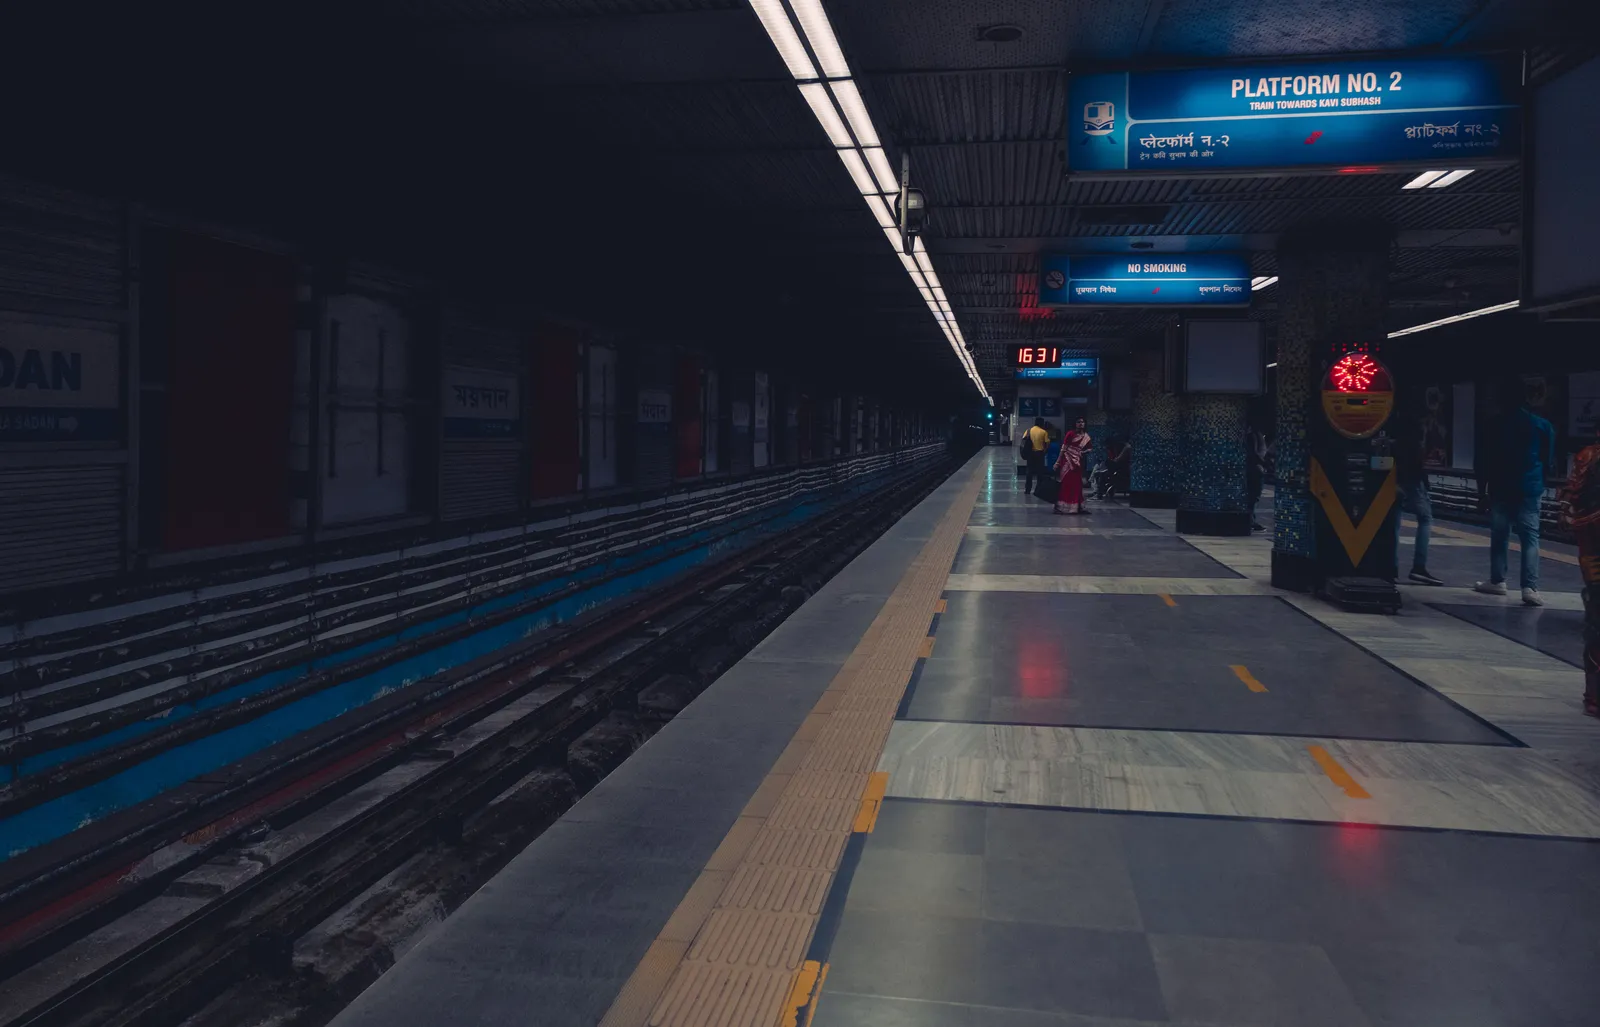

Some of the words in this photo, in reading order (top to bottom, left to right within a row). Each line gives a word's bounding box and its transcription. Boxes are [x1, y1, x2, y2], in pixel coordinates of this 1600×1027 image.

[1231, 74, 1340, 98] PLATFORM
[1347, 72, 1383, 94] NO.
[1389, 71, 1403, 91] 2
[1249, 101, 1275, 111] TRAIN
[1276, 99, 1318, 110] TOWARDS
[1319, 98, 1339, 108] KAVI
[1341, 97, 1382, 107] SUBHASH
[1139, 132, 1194, 148] प्लेटफॉर्म
[1153, 150, 1166, 159] कवि
[1189, 149, 1199, 158] की
[1127, 263, 1141, 273] NO
[1143, 263, 1187, 273] SMOKING
[451, 385, 511, 410] ময়দান
